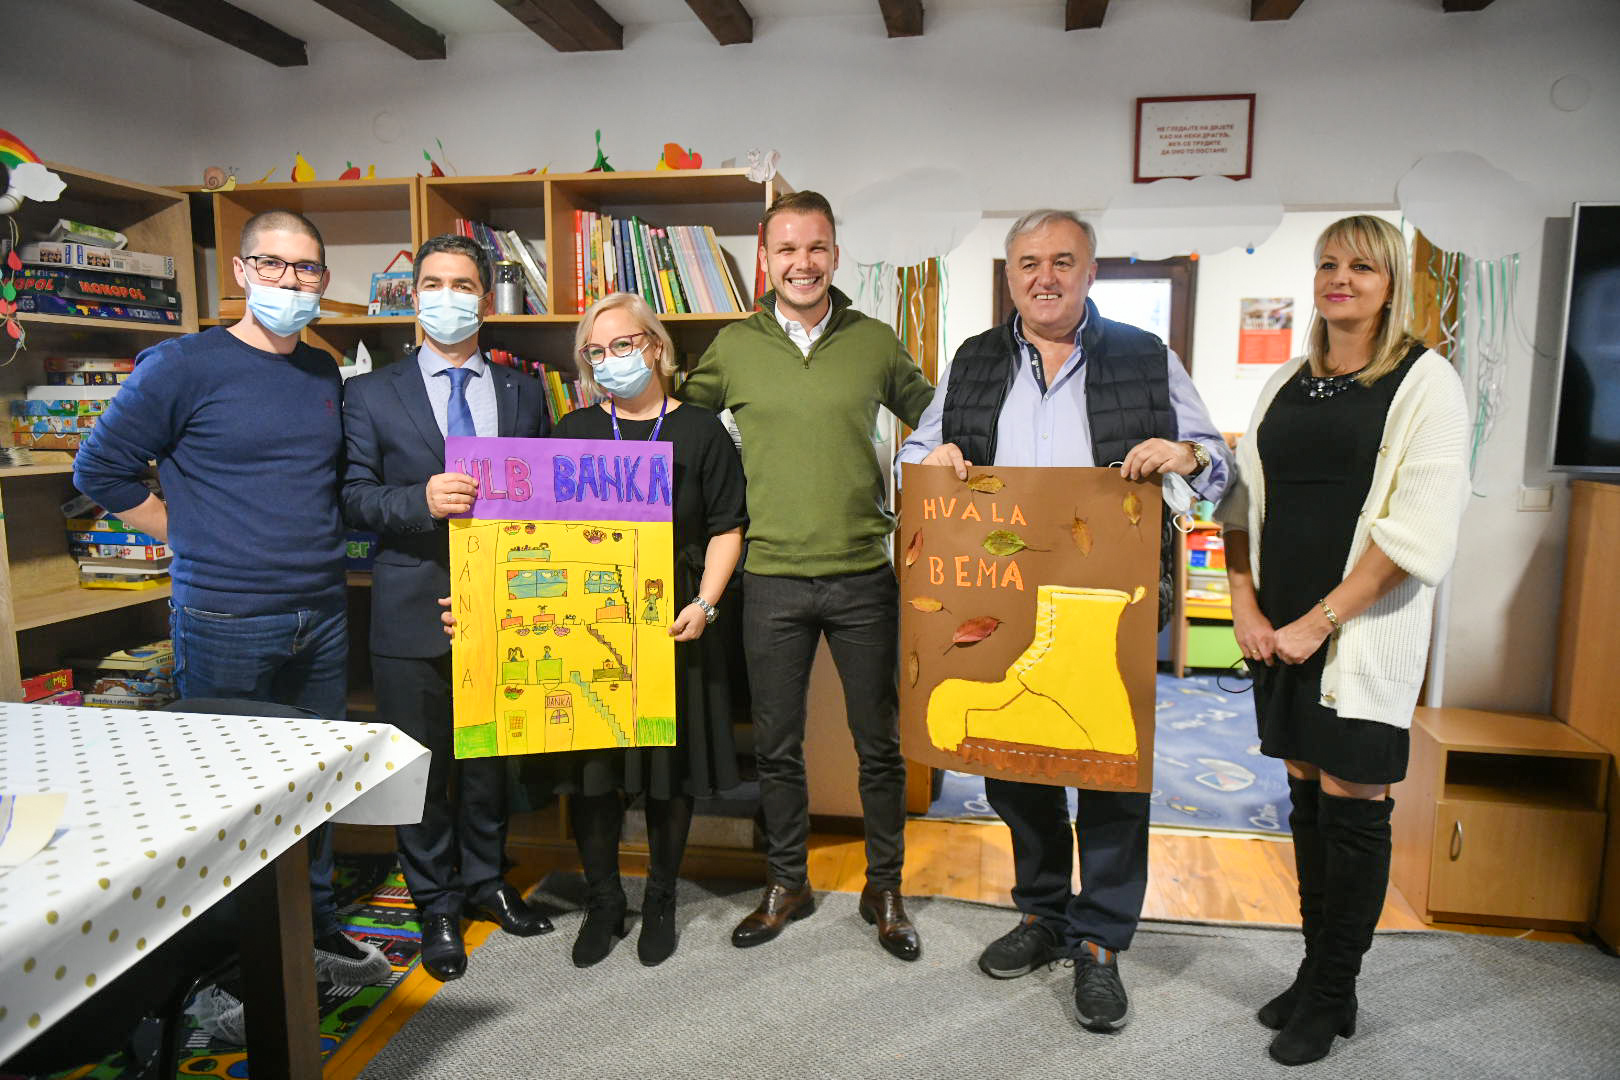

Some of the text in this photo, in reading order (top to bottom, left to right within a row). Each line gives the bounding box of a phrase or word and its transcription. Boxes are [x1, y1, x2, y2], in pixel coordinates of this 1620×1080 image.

[553, 453, 673, 506] BANKA
[923, 496, 1027, 525] HVALA
[928, 555, 1025, 591] BEMA
